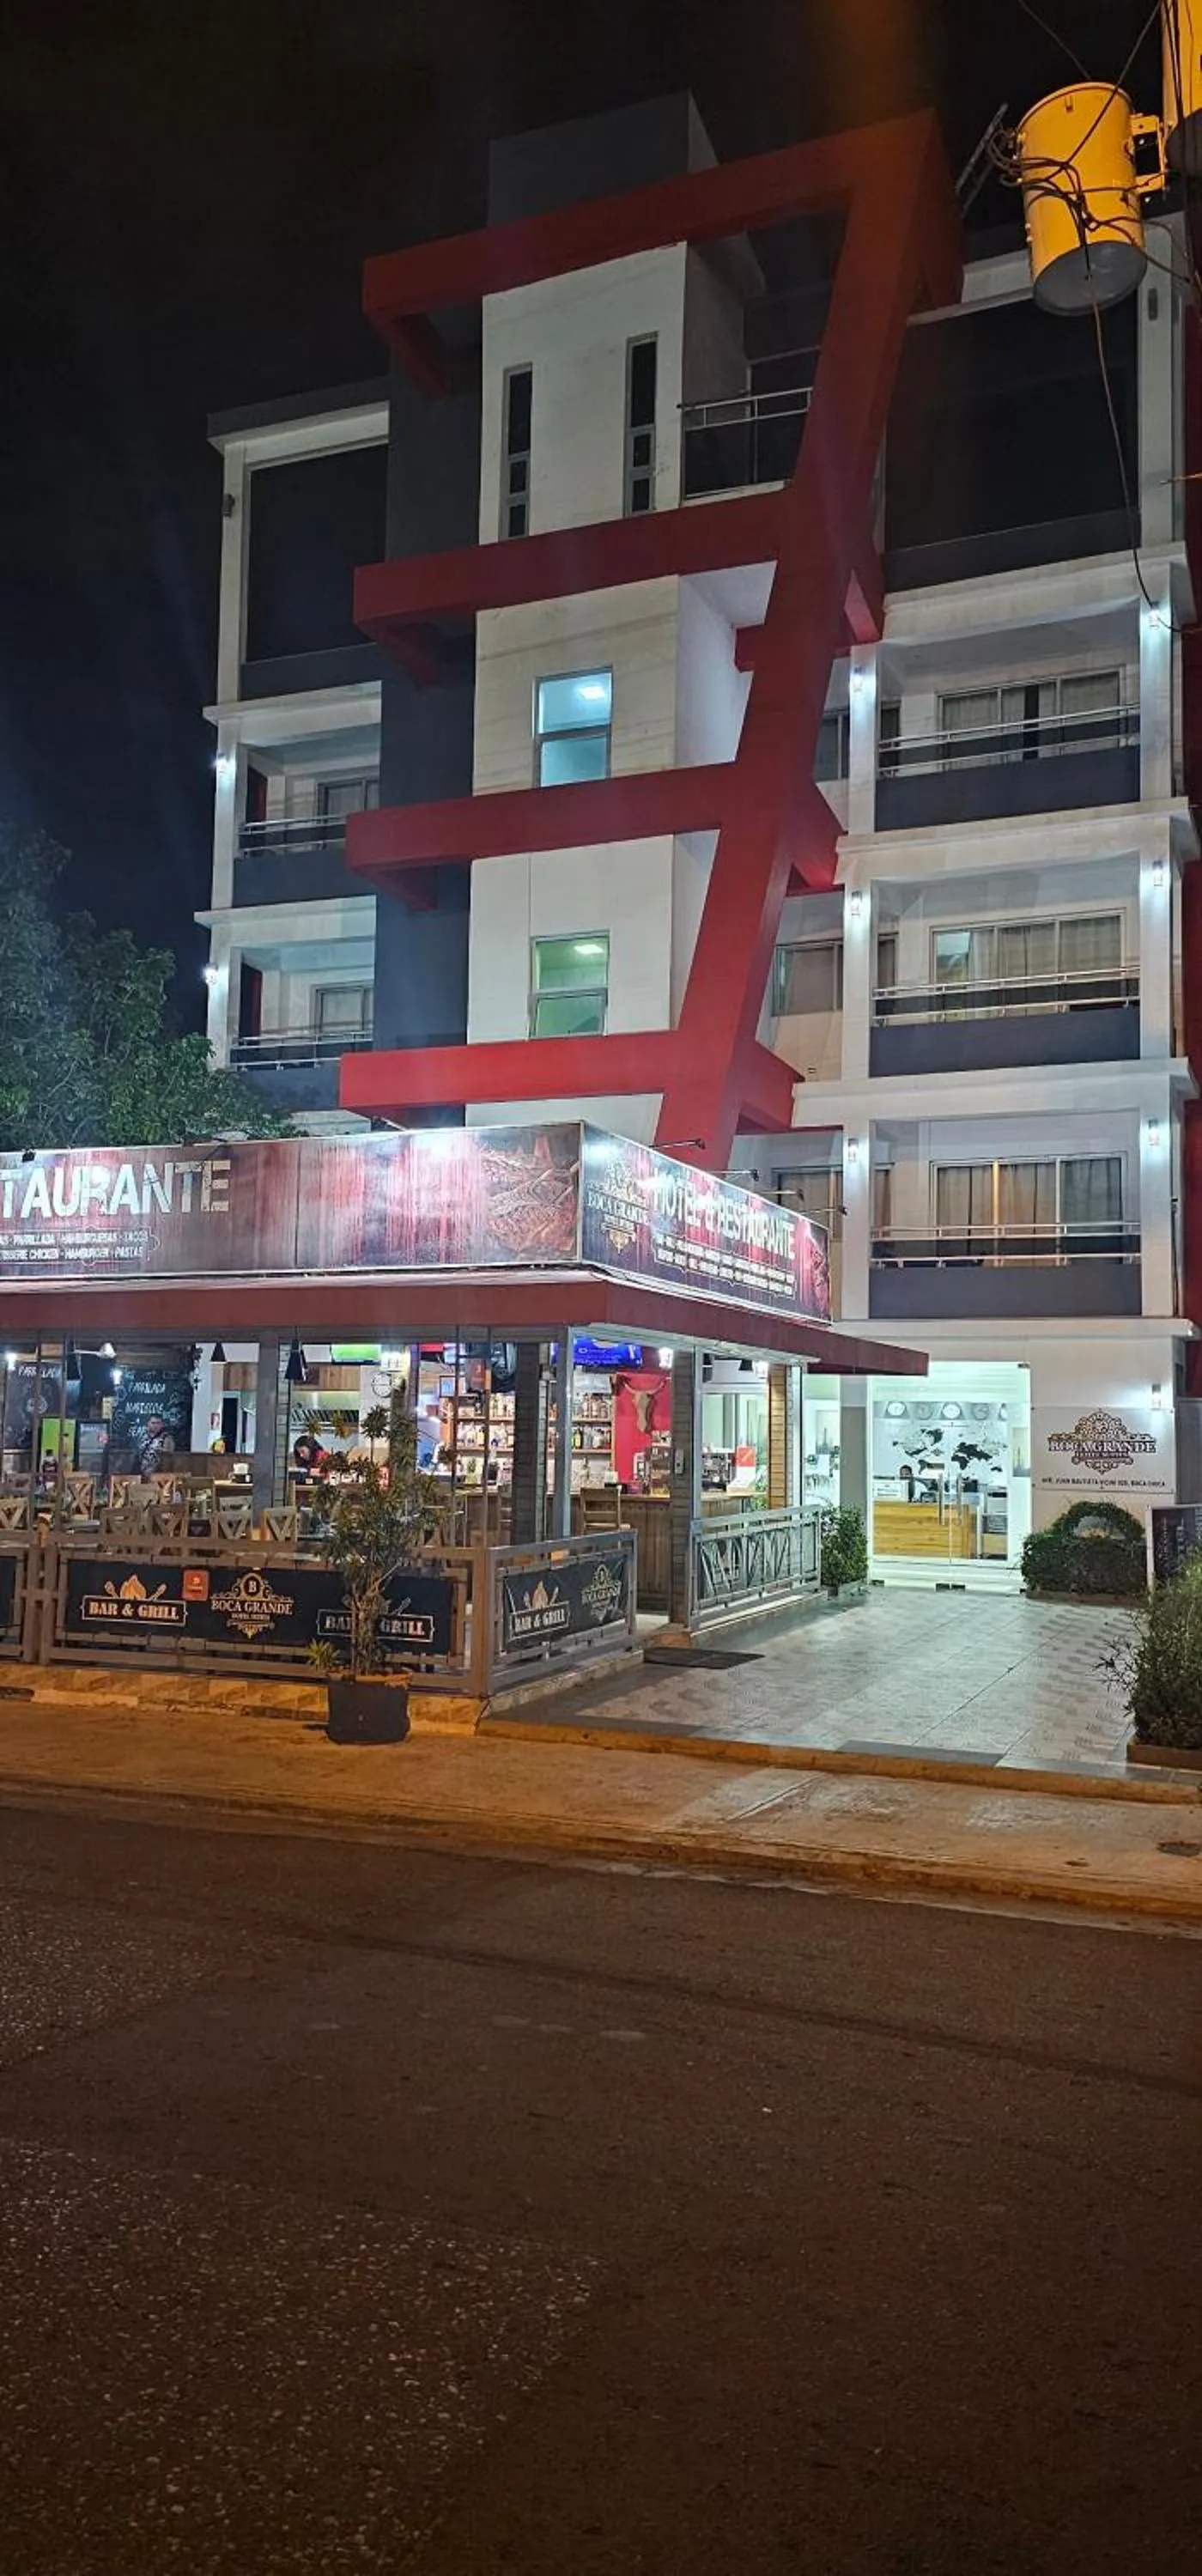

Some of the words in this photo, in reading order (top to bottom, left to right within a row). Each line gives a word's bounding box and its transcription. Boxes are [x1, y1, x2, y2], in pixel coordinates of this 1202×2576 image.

[1092, 1441, 1156, 1453] GRANDE
[89, 1601, 118, 1615] BAR
[122, 1603, 134, 1616] &
[138, 1604, 179, 1620] GRILL
[211, 1599, 241, 1613] BOCA
[244, 1601, 293, 1615] GRANDE
[380, 1618, 425, 1636] GRILL
[515, 1614, 531, 1632] BAR
[543, 1608, 565, 1626] GRILL
